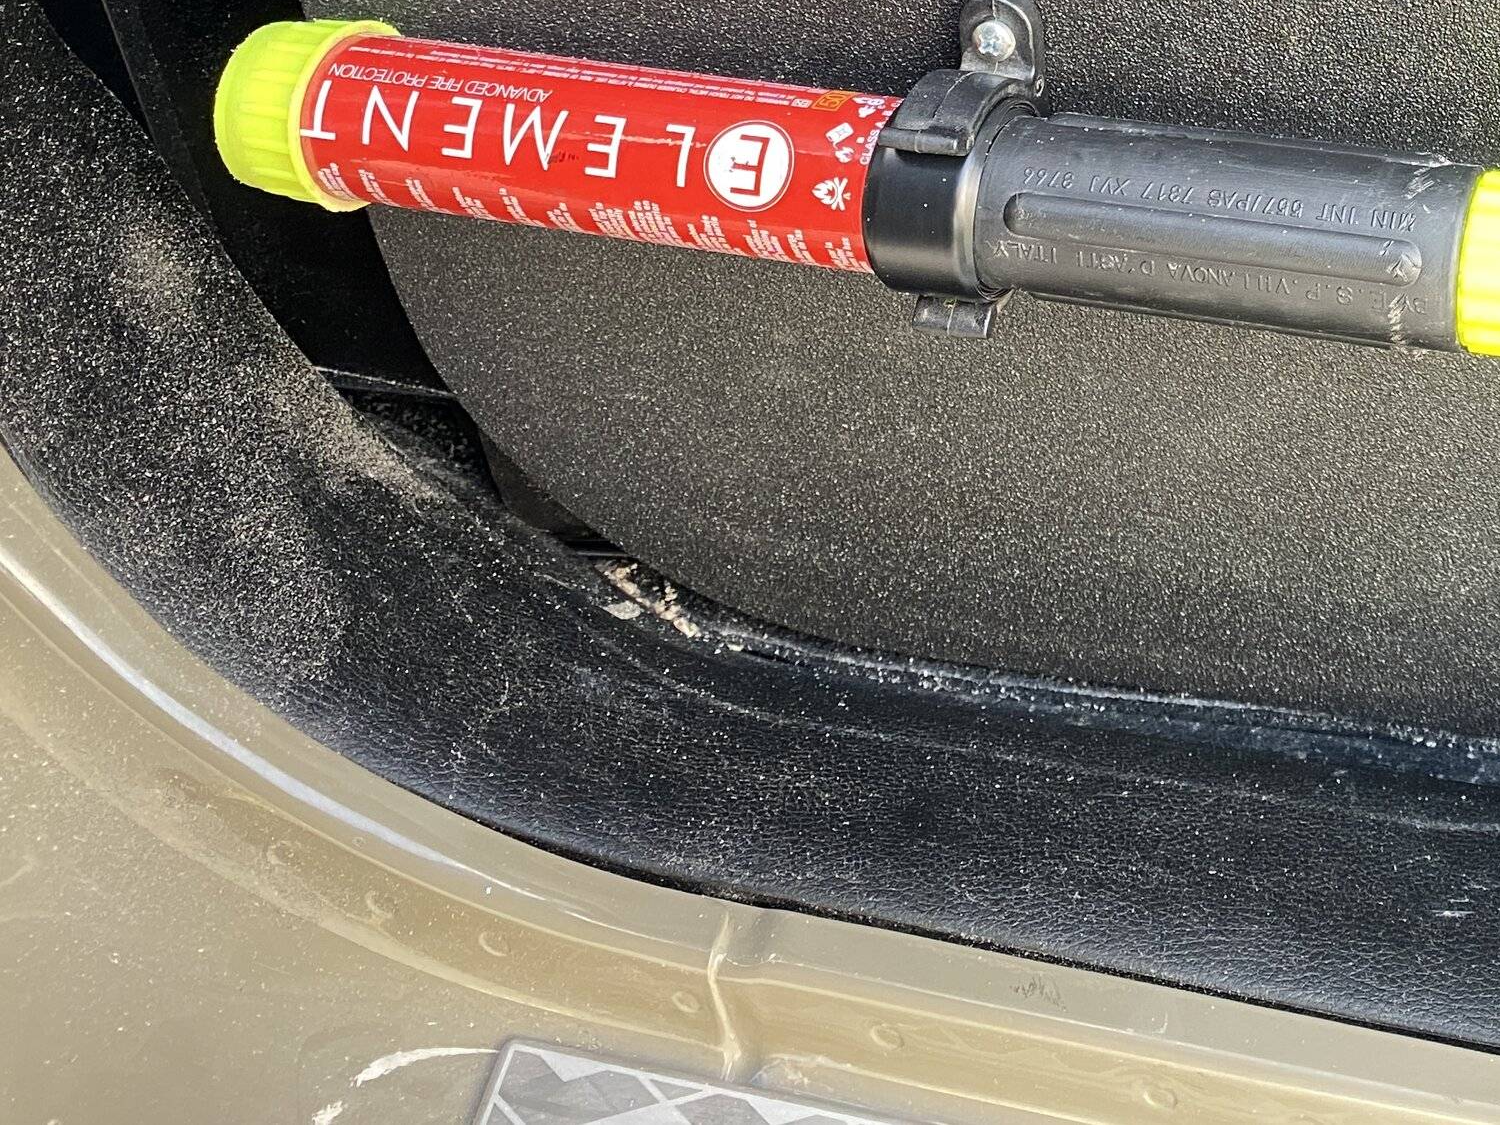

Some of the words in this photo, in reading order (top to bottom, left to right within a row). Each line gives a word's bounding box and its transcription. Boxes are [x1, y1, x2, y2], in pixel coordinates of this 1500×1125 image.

[328, 62, 428, 88] PROTECTION
[428, 75, 464, 93] FIRE
[465, 80, 553, 103] ADVANCED
[299, 80, 775, 199] ELEMENT
[1371, 209, 1416, 232] MIN
[992, 240, 1058, 265] ITALY
